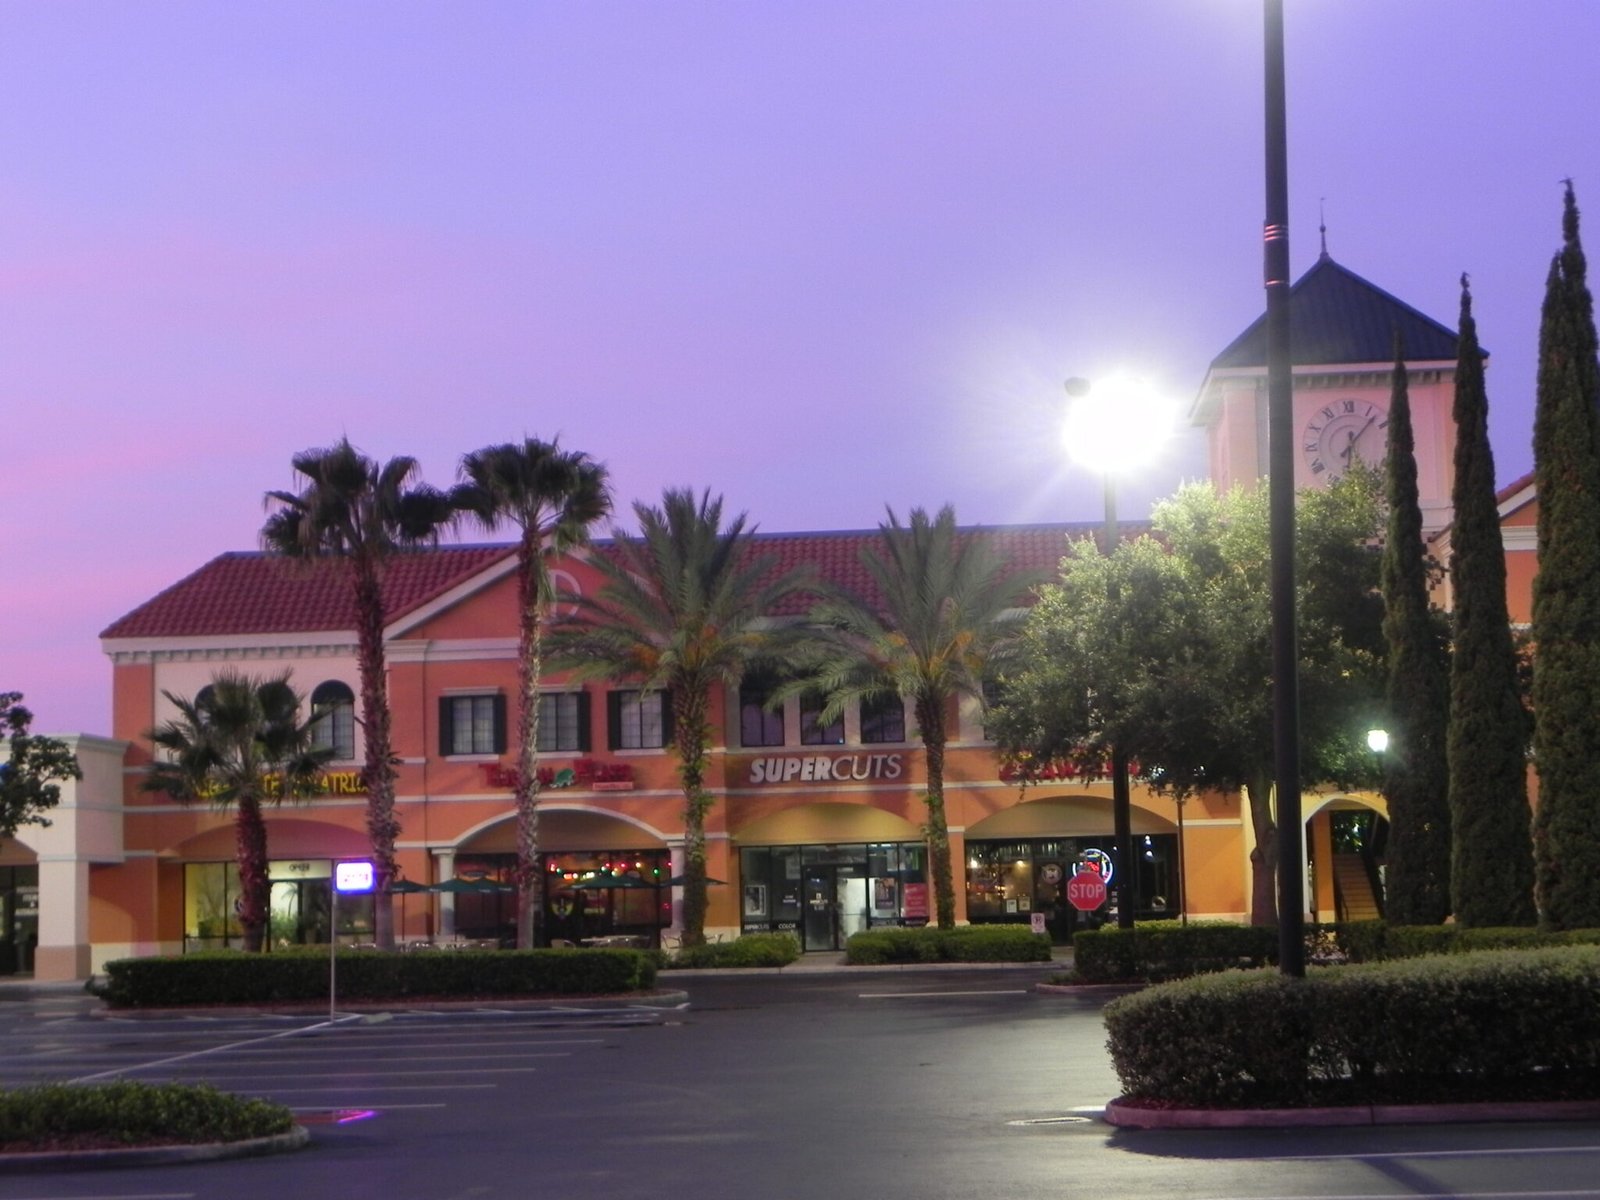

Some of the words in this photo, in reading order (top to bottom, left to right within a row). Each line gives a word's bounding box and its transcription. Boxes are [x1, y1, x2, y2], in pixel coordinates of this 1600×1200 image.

[1322, 407, 1335, 420] XI
[1343, 401, 1354, 413] XII
[1305, 443, 1318, 452] IX
[750, 754, 903, 784] SUPERCUTS
[1070, 883, 1104, 898] STOP
